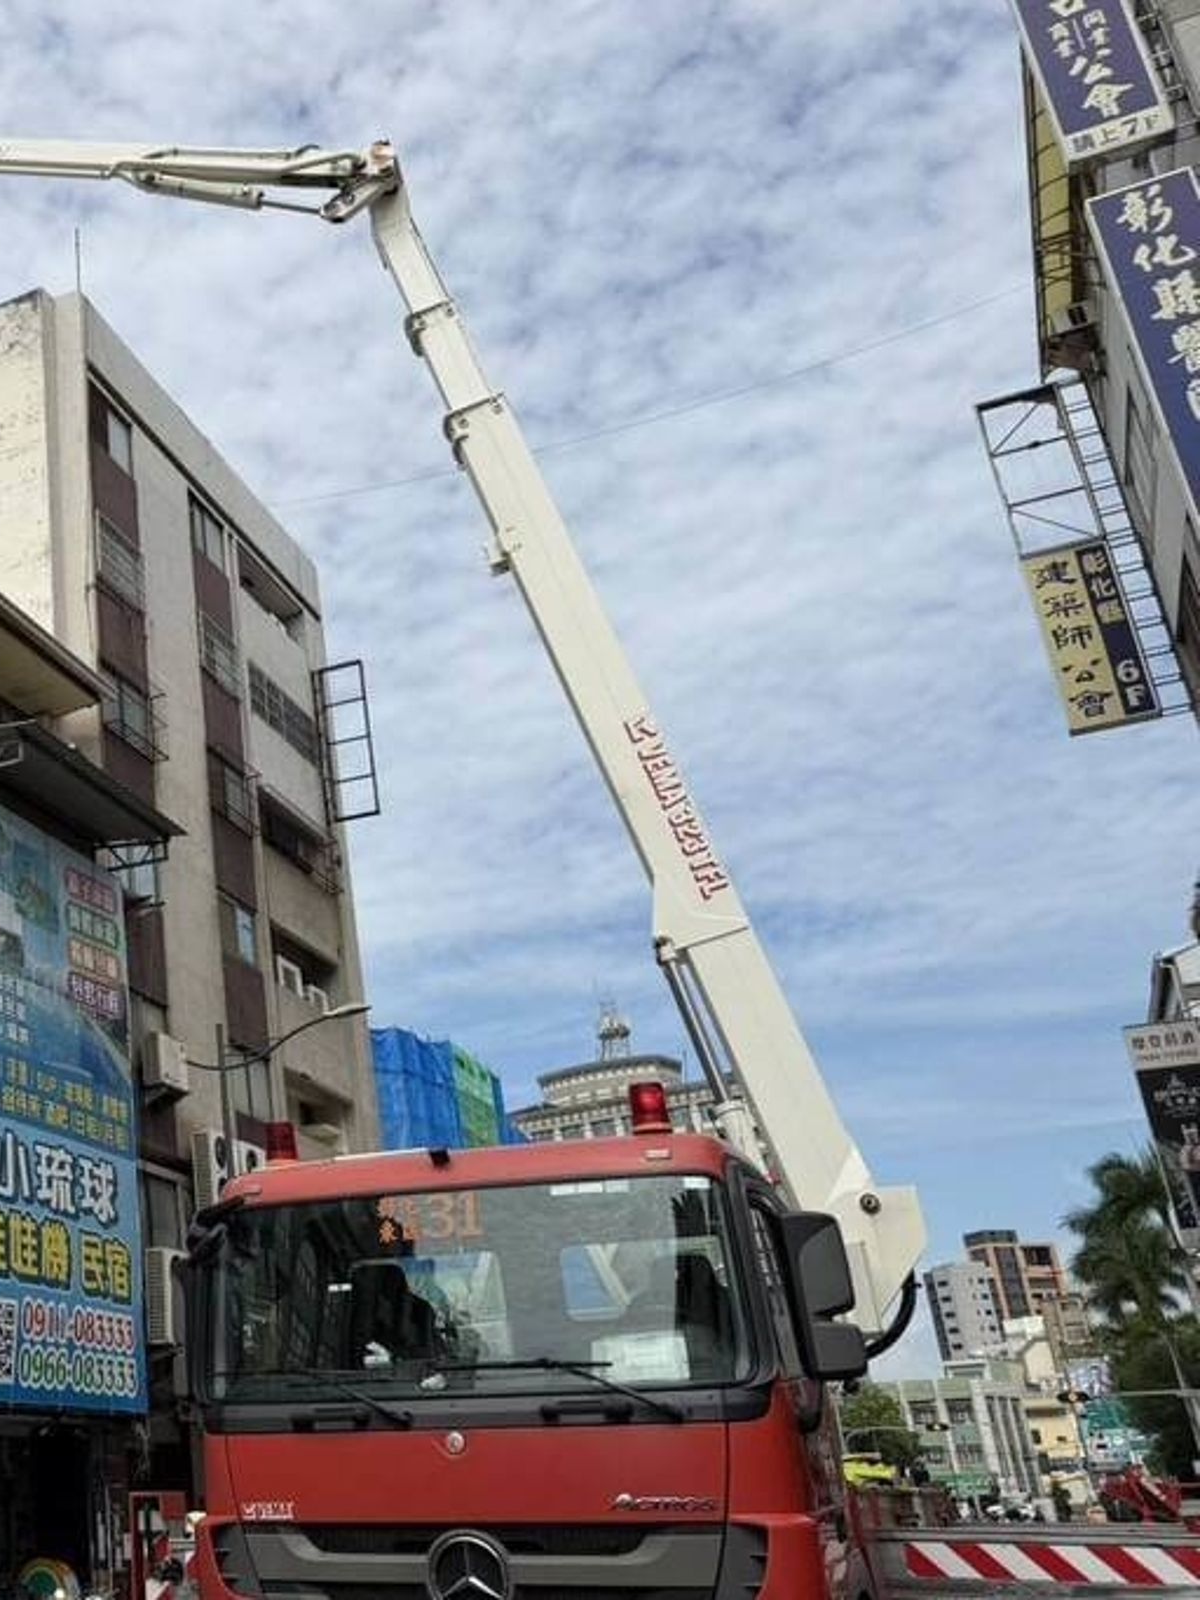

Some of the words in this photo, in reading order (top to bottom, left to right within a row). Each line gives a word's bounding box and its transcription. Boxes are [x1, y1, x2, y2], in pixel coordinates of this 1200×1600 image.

[1033, 560, 1114, 718] 建築師公會
[1118, 660, 1146, 707] 6F
